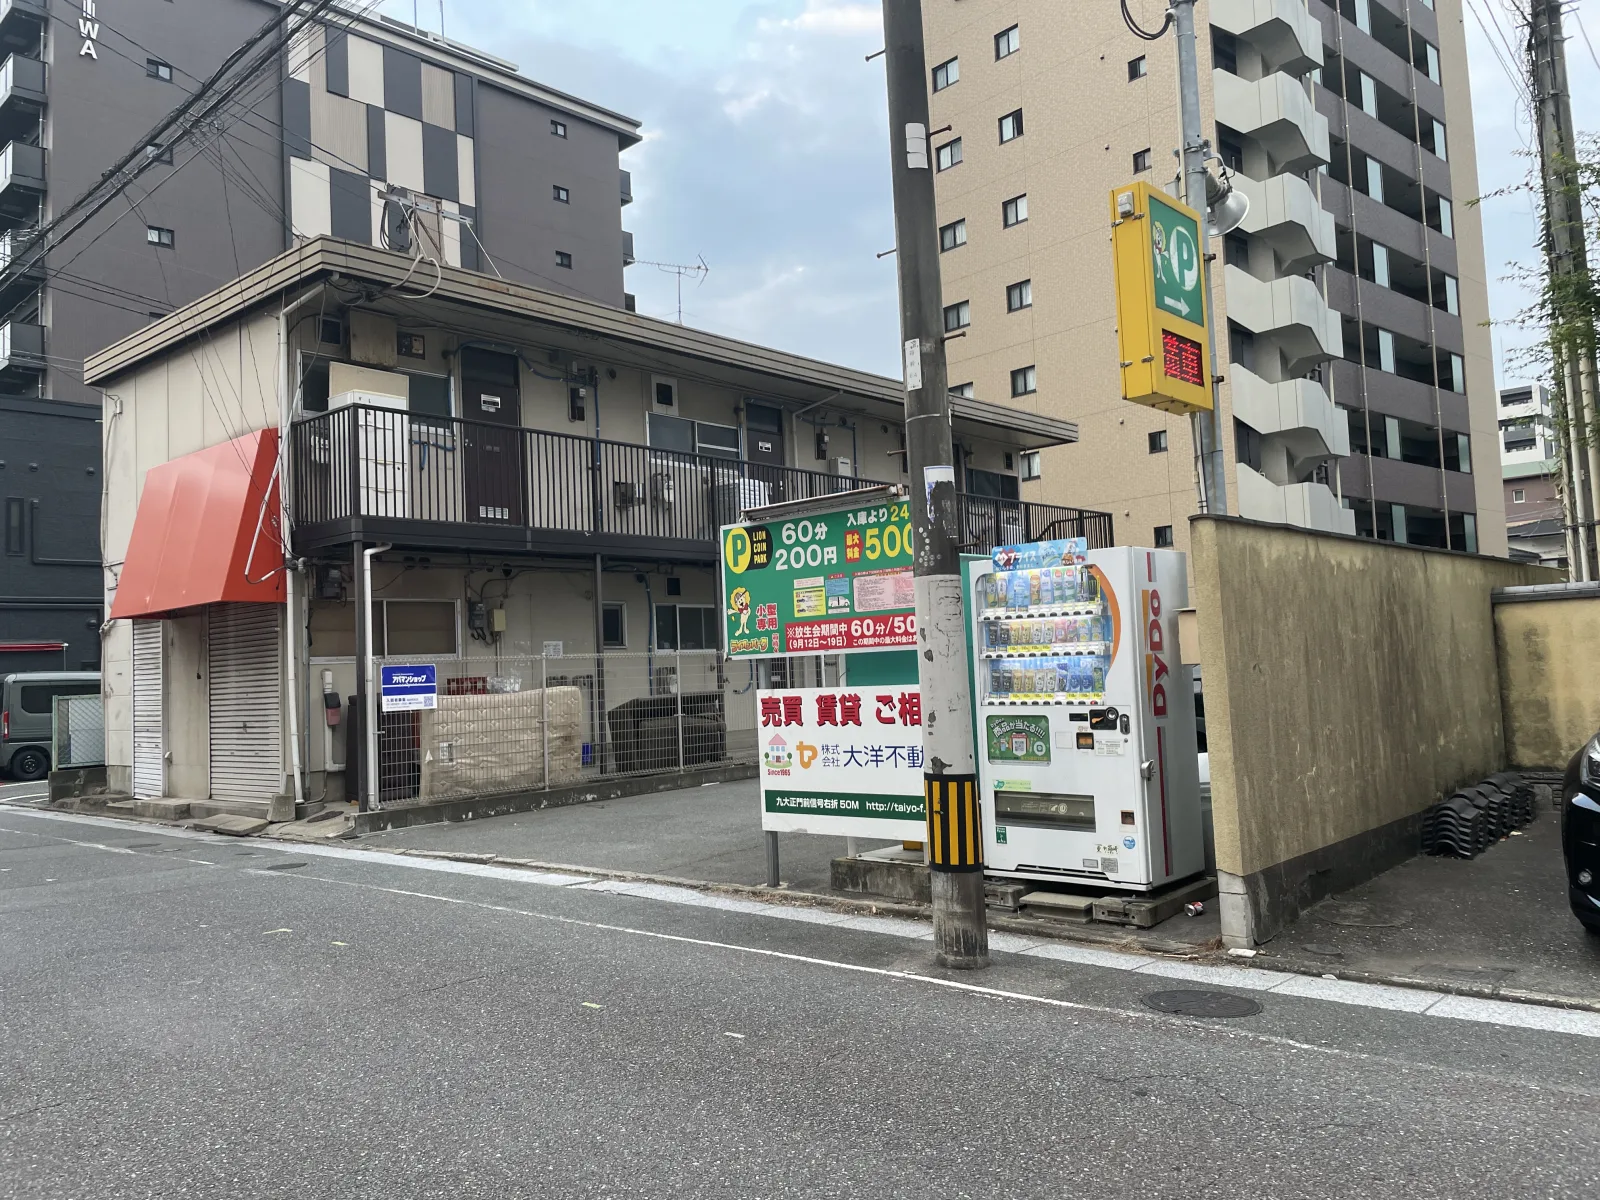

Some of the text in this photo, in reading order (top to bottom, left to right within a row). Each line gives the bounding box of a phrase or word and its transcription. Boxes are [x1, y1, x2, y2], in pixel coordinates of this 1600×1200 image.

[1174, 228, 1195, 288] P
[752, 530, 767, 541] LION
[782, 520, 828, 545] 60分
[731, 533, 747, 568] P
[753, 541, 767, 553] COIN
[753, 553, 767, 564] PARK
[775, 544, 837, 571] 200円
[756, 602, 778, 618] 小型
[756, 617, 778, 631] 専用
[392, 675, 426, 683] アパマンショップ
[761, 696, 803, 727] 売買
[816, 693, 862, 727] 賃貸
[821, 744, 840, 755] 株式
[843, 744, 924, 769] 大洋不動
[821, 756, 840, 768] 会社
[840, 799, 859, 810] 50M
